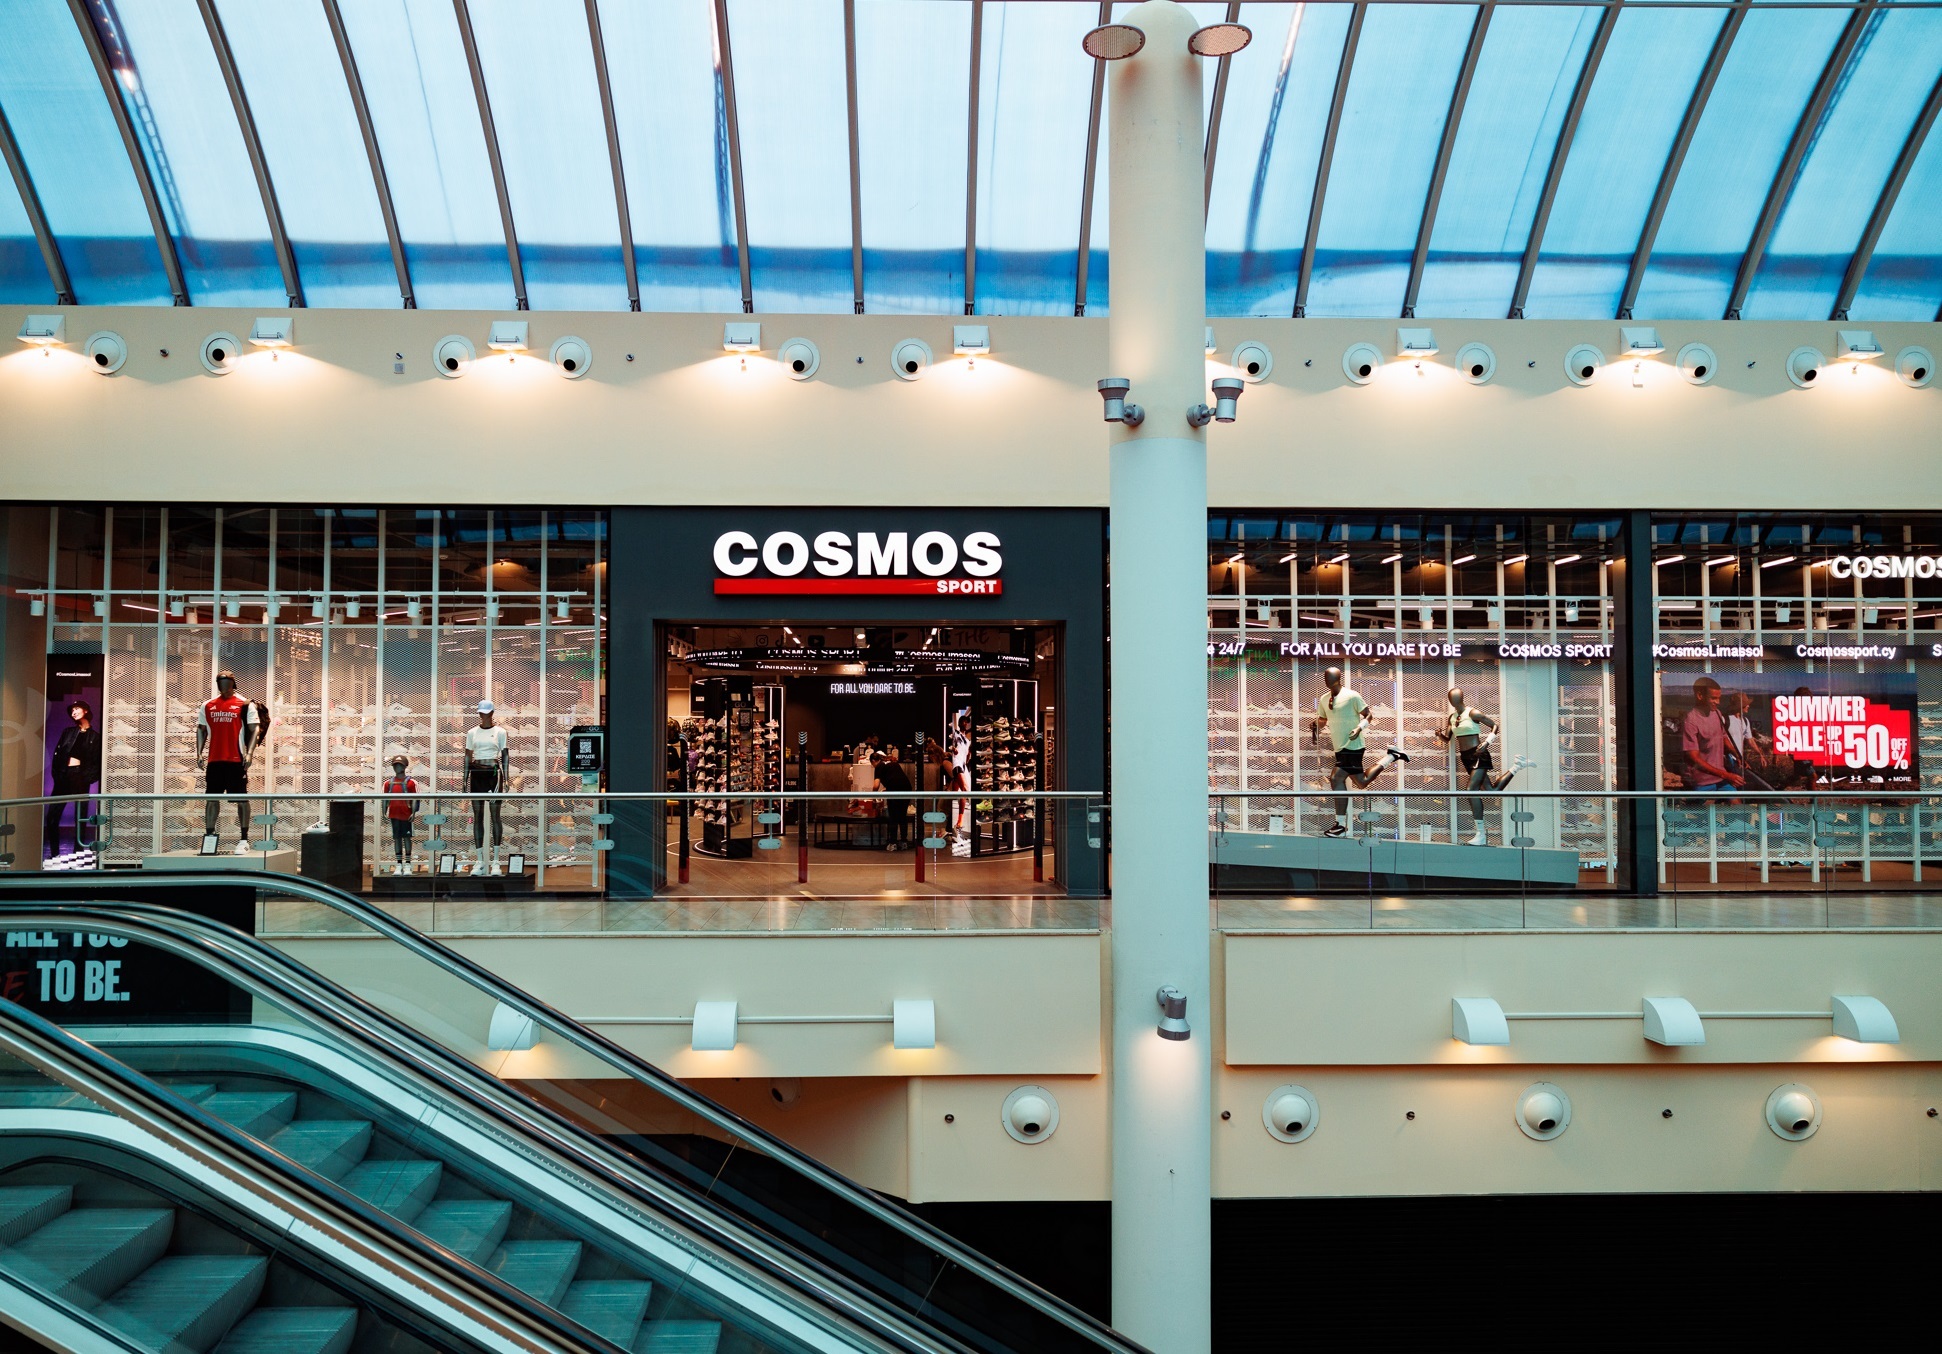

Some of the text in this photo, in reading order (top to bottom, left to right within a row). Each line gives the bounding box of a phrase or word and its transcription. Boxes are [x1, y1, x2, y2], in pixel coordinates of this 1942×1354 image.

[713, 531, 1002, 576] COSMOS
[936, 580, 997, 593] SPORT
[1218, 643, 1246, 655] 24/7
[1280, 643, 1462, 657] FOR ALL YOU DARE TO BE
[1499, 644, 1613, 657] COSMOS SPORT
[1652, 644, 1763, 657] #CosmosLimassol
[1796, 644, 1896, 659] Cosmossport.cy
[830, 683, 916, 694] FOR ALL YOU DARE TO BE.
[1775, 696, 1866, 722] SUMMER
[1775, 724, 1907, 769] SALE UP 50 OFF
[1827, 741, 1842, 755] TO
[36, 960, 76, 1002] TO
[84, 960, 130, 1002] BE.
